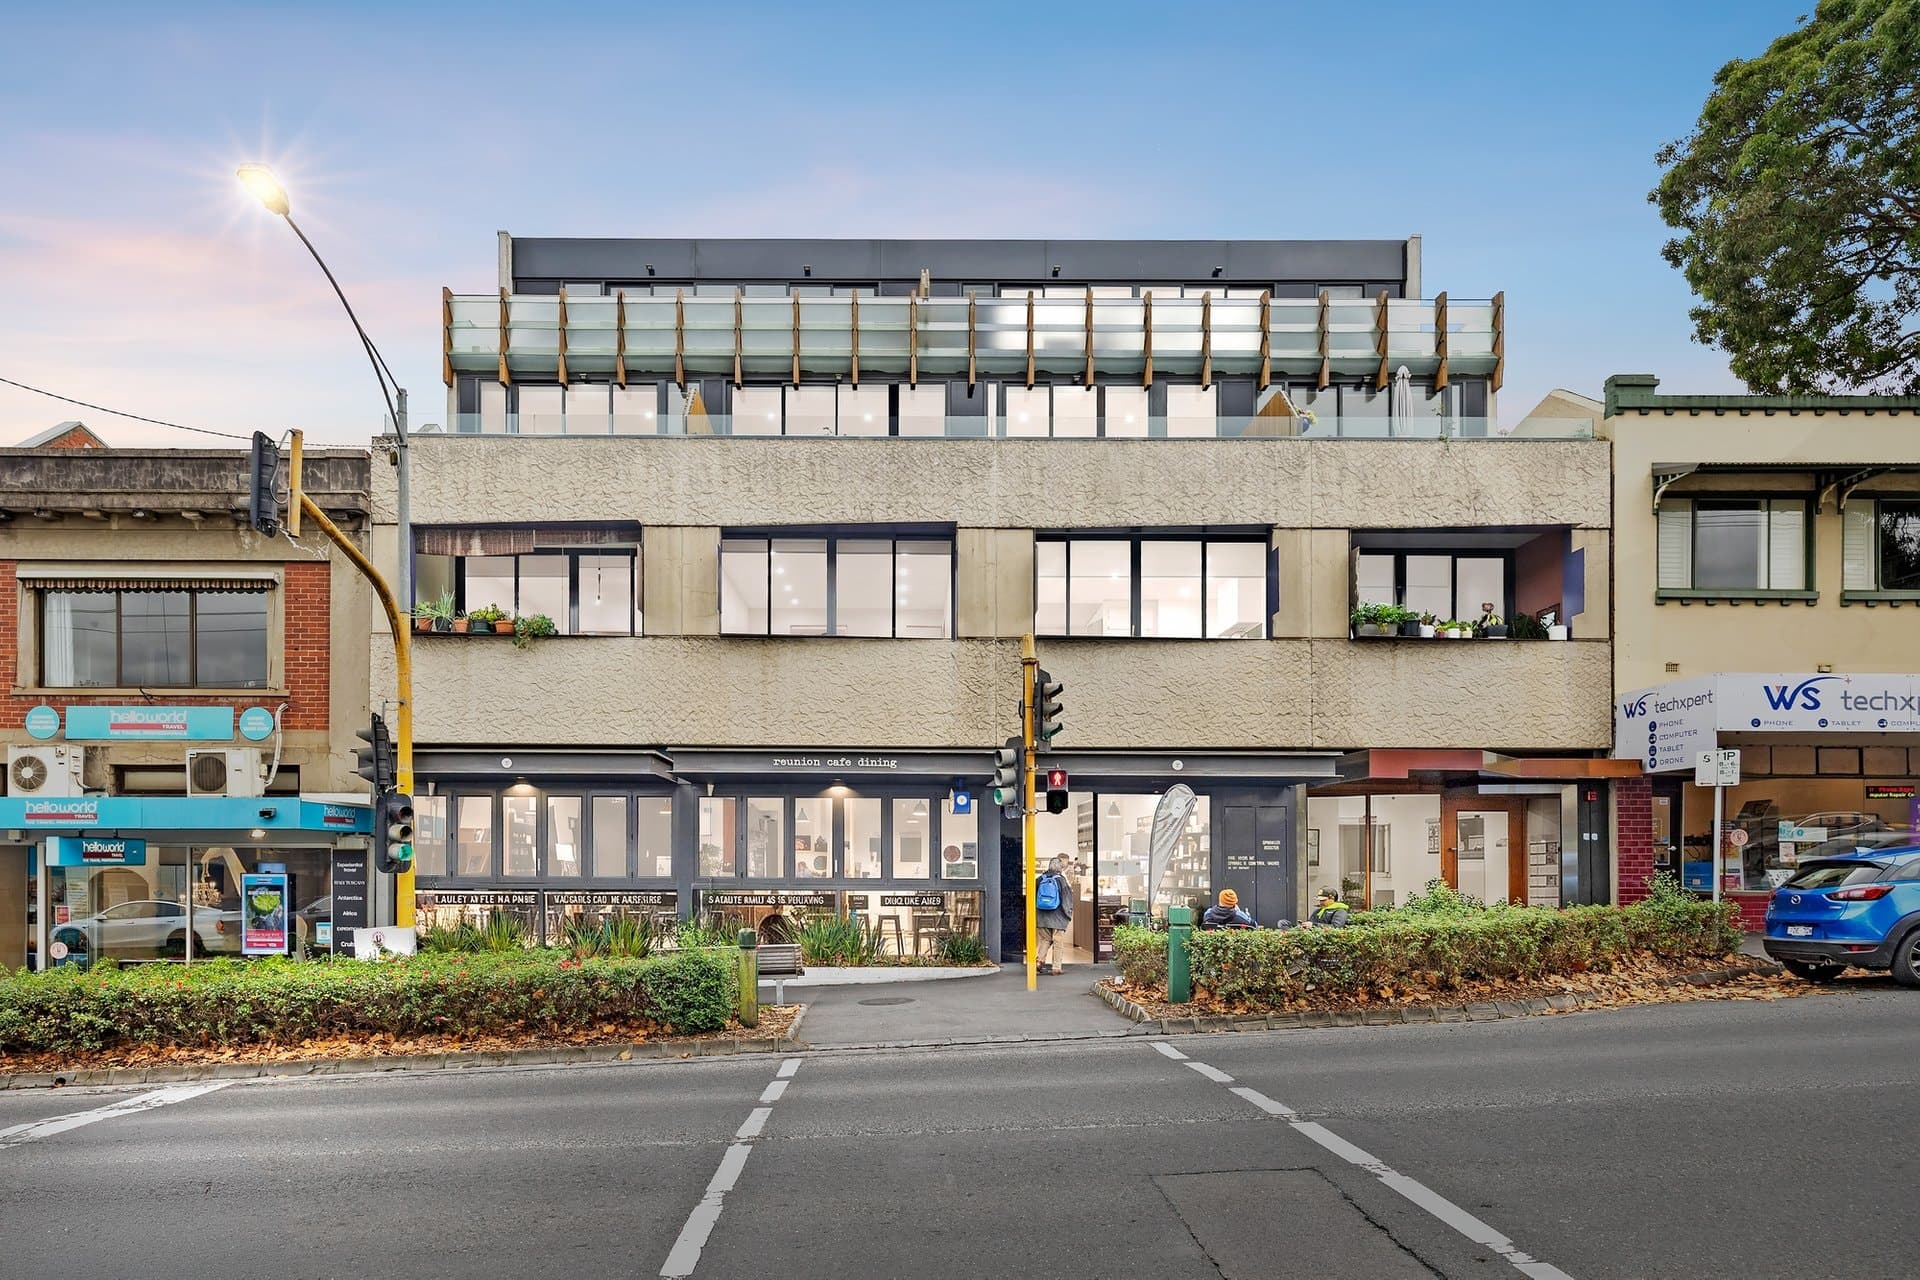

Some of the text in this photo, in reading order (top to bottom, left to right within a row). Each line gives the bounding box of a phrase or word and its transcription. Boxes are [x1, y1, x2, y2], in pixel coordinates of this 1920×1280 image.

[1763, 677, 1822, 711] WS
[1623, 693, 1647, 719] WS
[1654, 690, 1713, 713] techxpert
[1660, 719, 1684, 728] PHONE
[1659, 729, 1698, 741] COMPUTER
[1659, 744, 1684, 753] TABLET
[1723, 751, 1735, 760] 1P
[773, 757, 898, 768] reunion cafe dining
[25, 801, 98, 813] helloworld
[82, 841, 125, 853] helloworld
